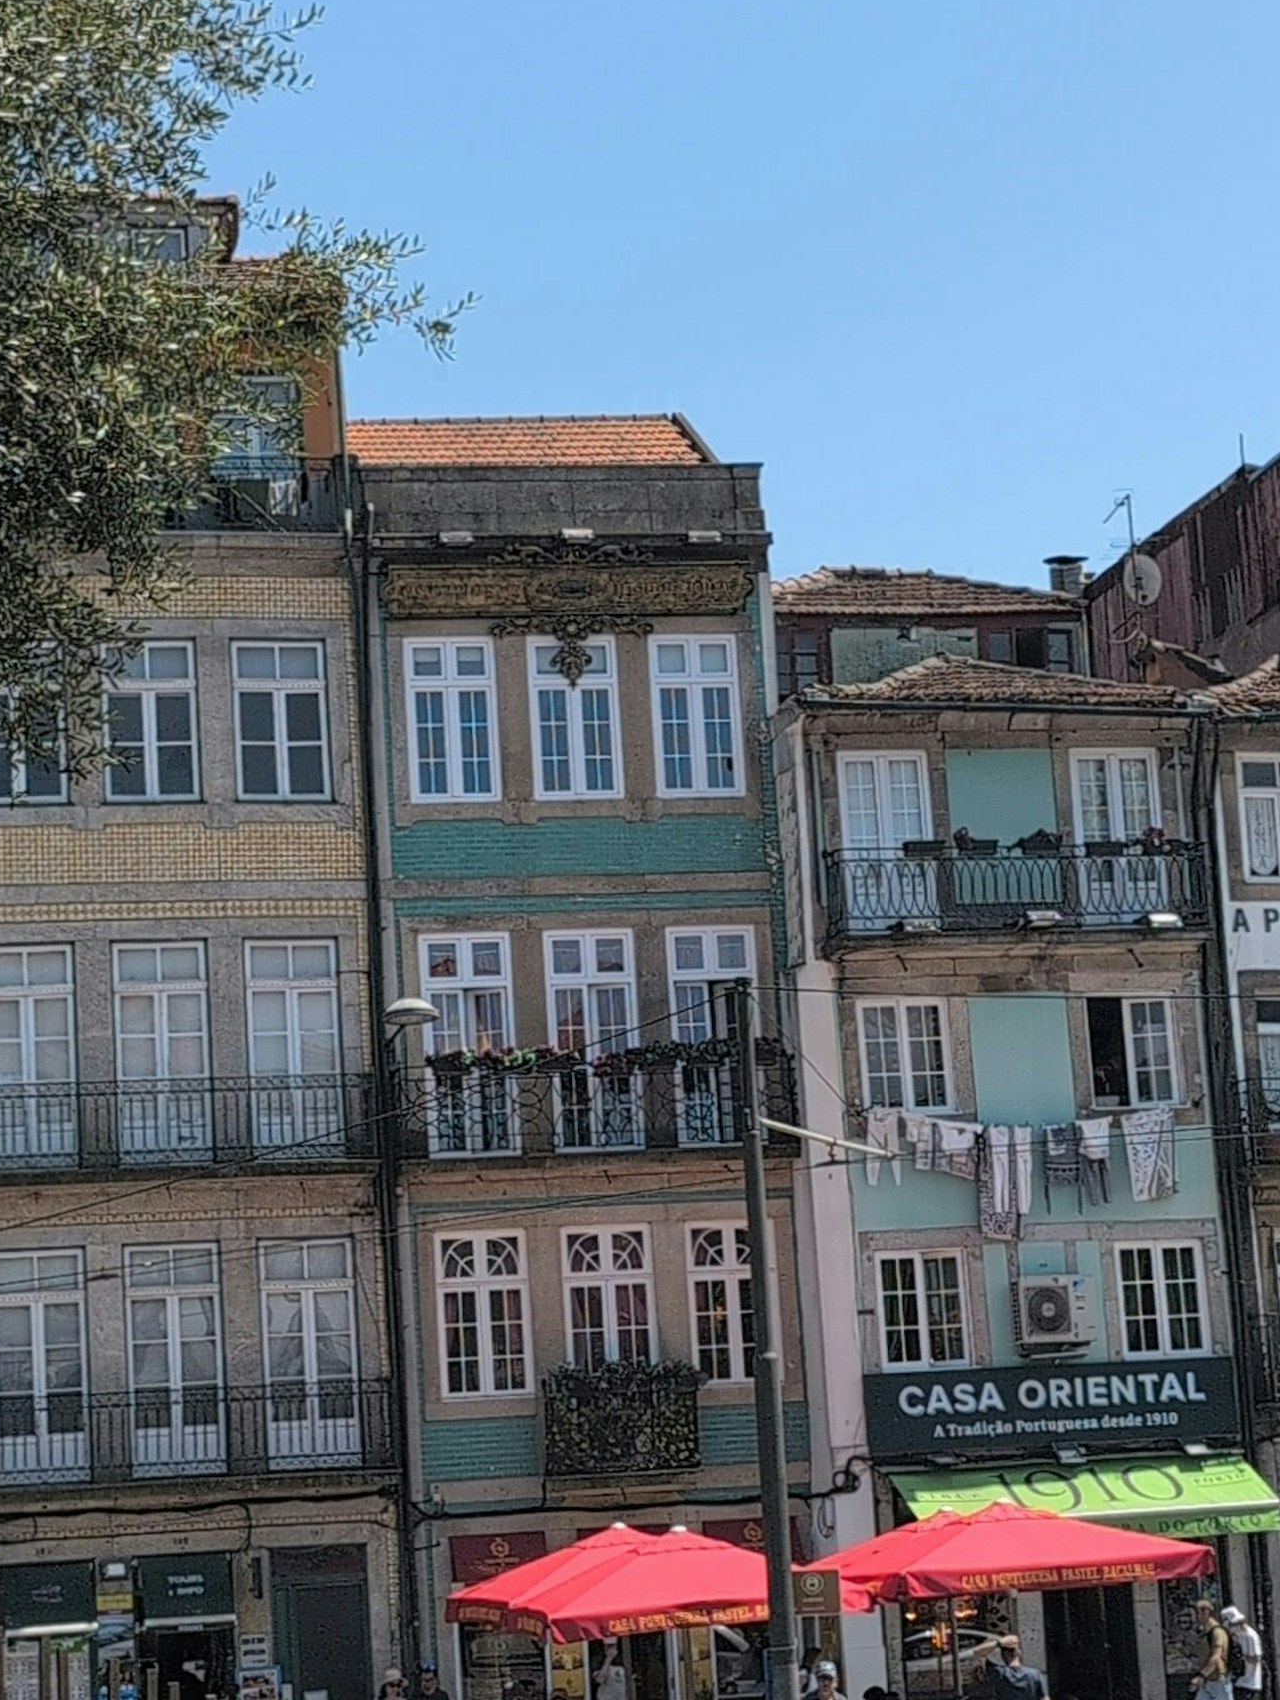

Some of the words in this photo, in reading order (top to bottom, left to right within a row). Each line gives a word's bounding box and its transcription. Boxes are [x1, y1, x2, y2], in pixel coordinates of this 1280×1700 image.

[1232, 908, 1250, 933] A
[898, 1381, 1005, 1417] CASA
[1018, 1371, 1207, 1410] ORIENTAL
[933, 1424, 945, 1438] A
[948, 1419, 1013, 1438] Tradição
[1016, 1415, 1099, 1434] Portuguesa
[1101, 1412, 1142, 1429] desde
[1145, 1411, 1179, 1427] 1910
[987, 1464, 1183, 1513] 1910
